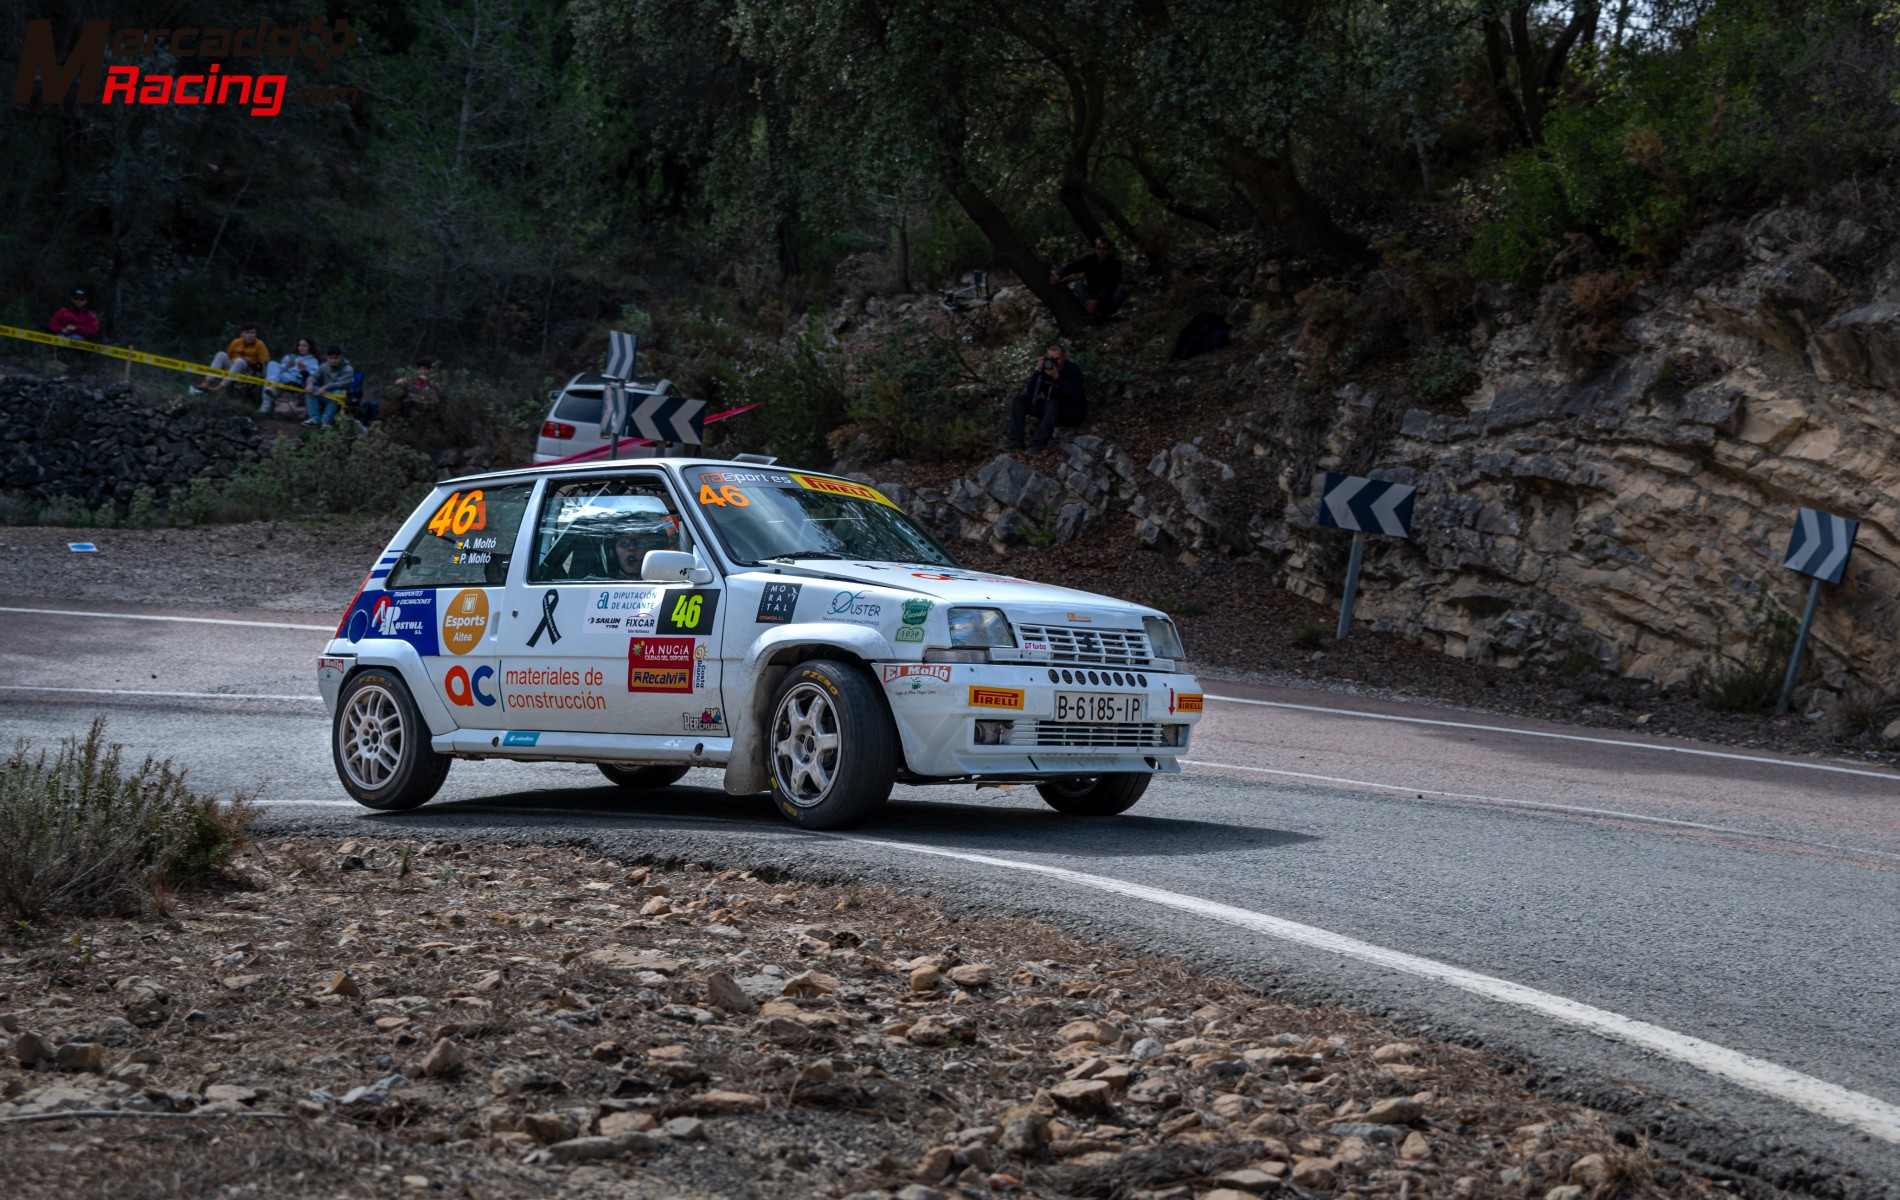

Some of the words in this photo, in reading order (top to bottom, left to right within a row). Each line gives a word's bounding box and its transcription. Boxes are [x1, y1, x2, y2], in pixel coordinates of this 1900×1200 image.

[699, 485, 750, 507] 46
[428, 490, 484, 537] 46
[463, 539, 471, 549] A.
[473, 538, 496, 549] Moltó
[460, 554, 468, 564] P.
[468, 552, 491, 564] Moltó
[622, 602, 655, 610] ALICANTE
[671, 594, 703, 629] 46
[446, 615, 485, 627] Esports
[625, 619, 655, 628] FIXCAR
[454, 632, 472, 642] Altea
[644, 645, 655, 655] LA
[506, 666, 579, 686] materiales
[583, 667, 603, 686] de
[643, 672, 678, 685] Recalvi
[886, 666, 901, 680] El
[444, 665, 496, 707] ac
[508, 692, 606, 710] construcción
[974, 690, 1018, 706] PIRELLI
[1059, 696, 1140, 721] B-6185-IP
